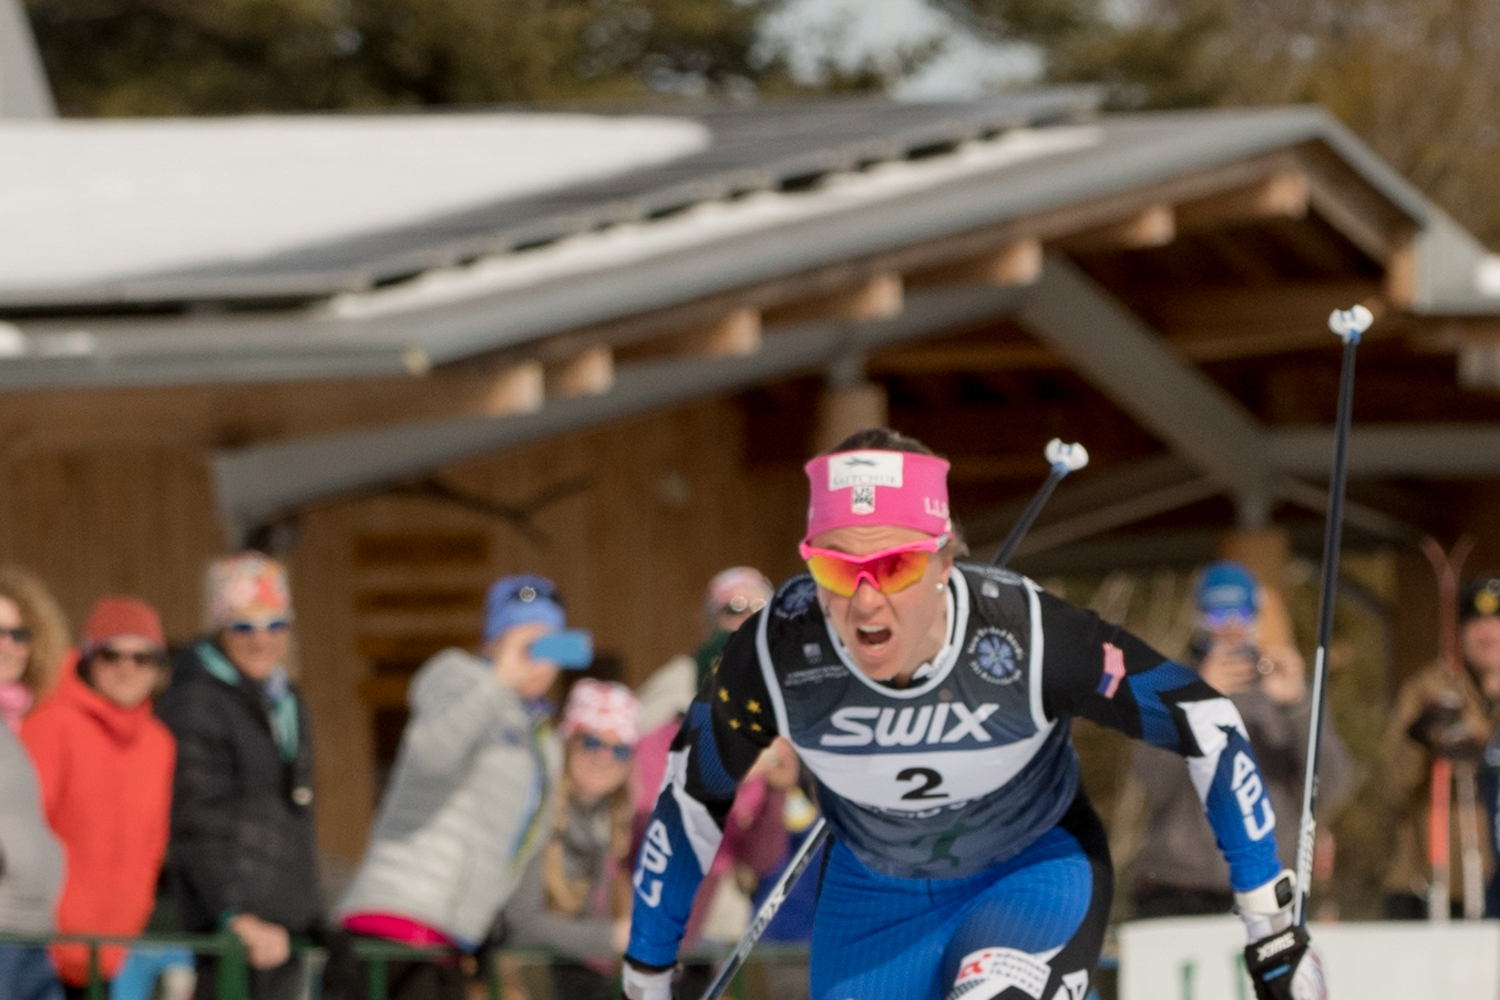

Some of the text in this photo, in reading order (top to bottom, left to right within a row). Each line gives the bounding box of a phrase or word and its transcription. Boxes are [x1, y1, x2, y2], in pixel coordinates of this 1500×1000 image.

[820, 702, 1000, 746] SWIX
[896, 767, 950, 801] 2
[1231, 750, 1276, 841] APU
